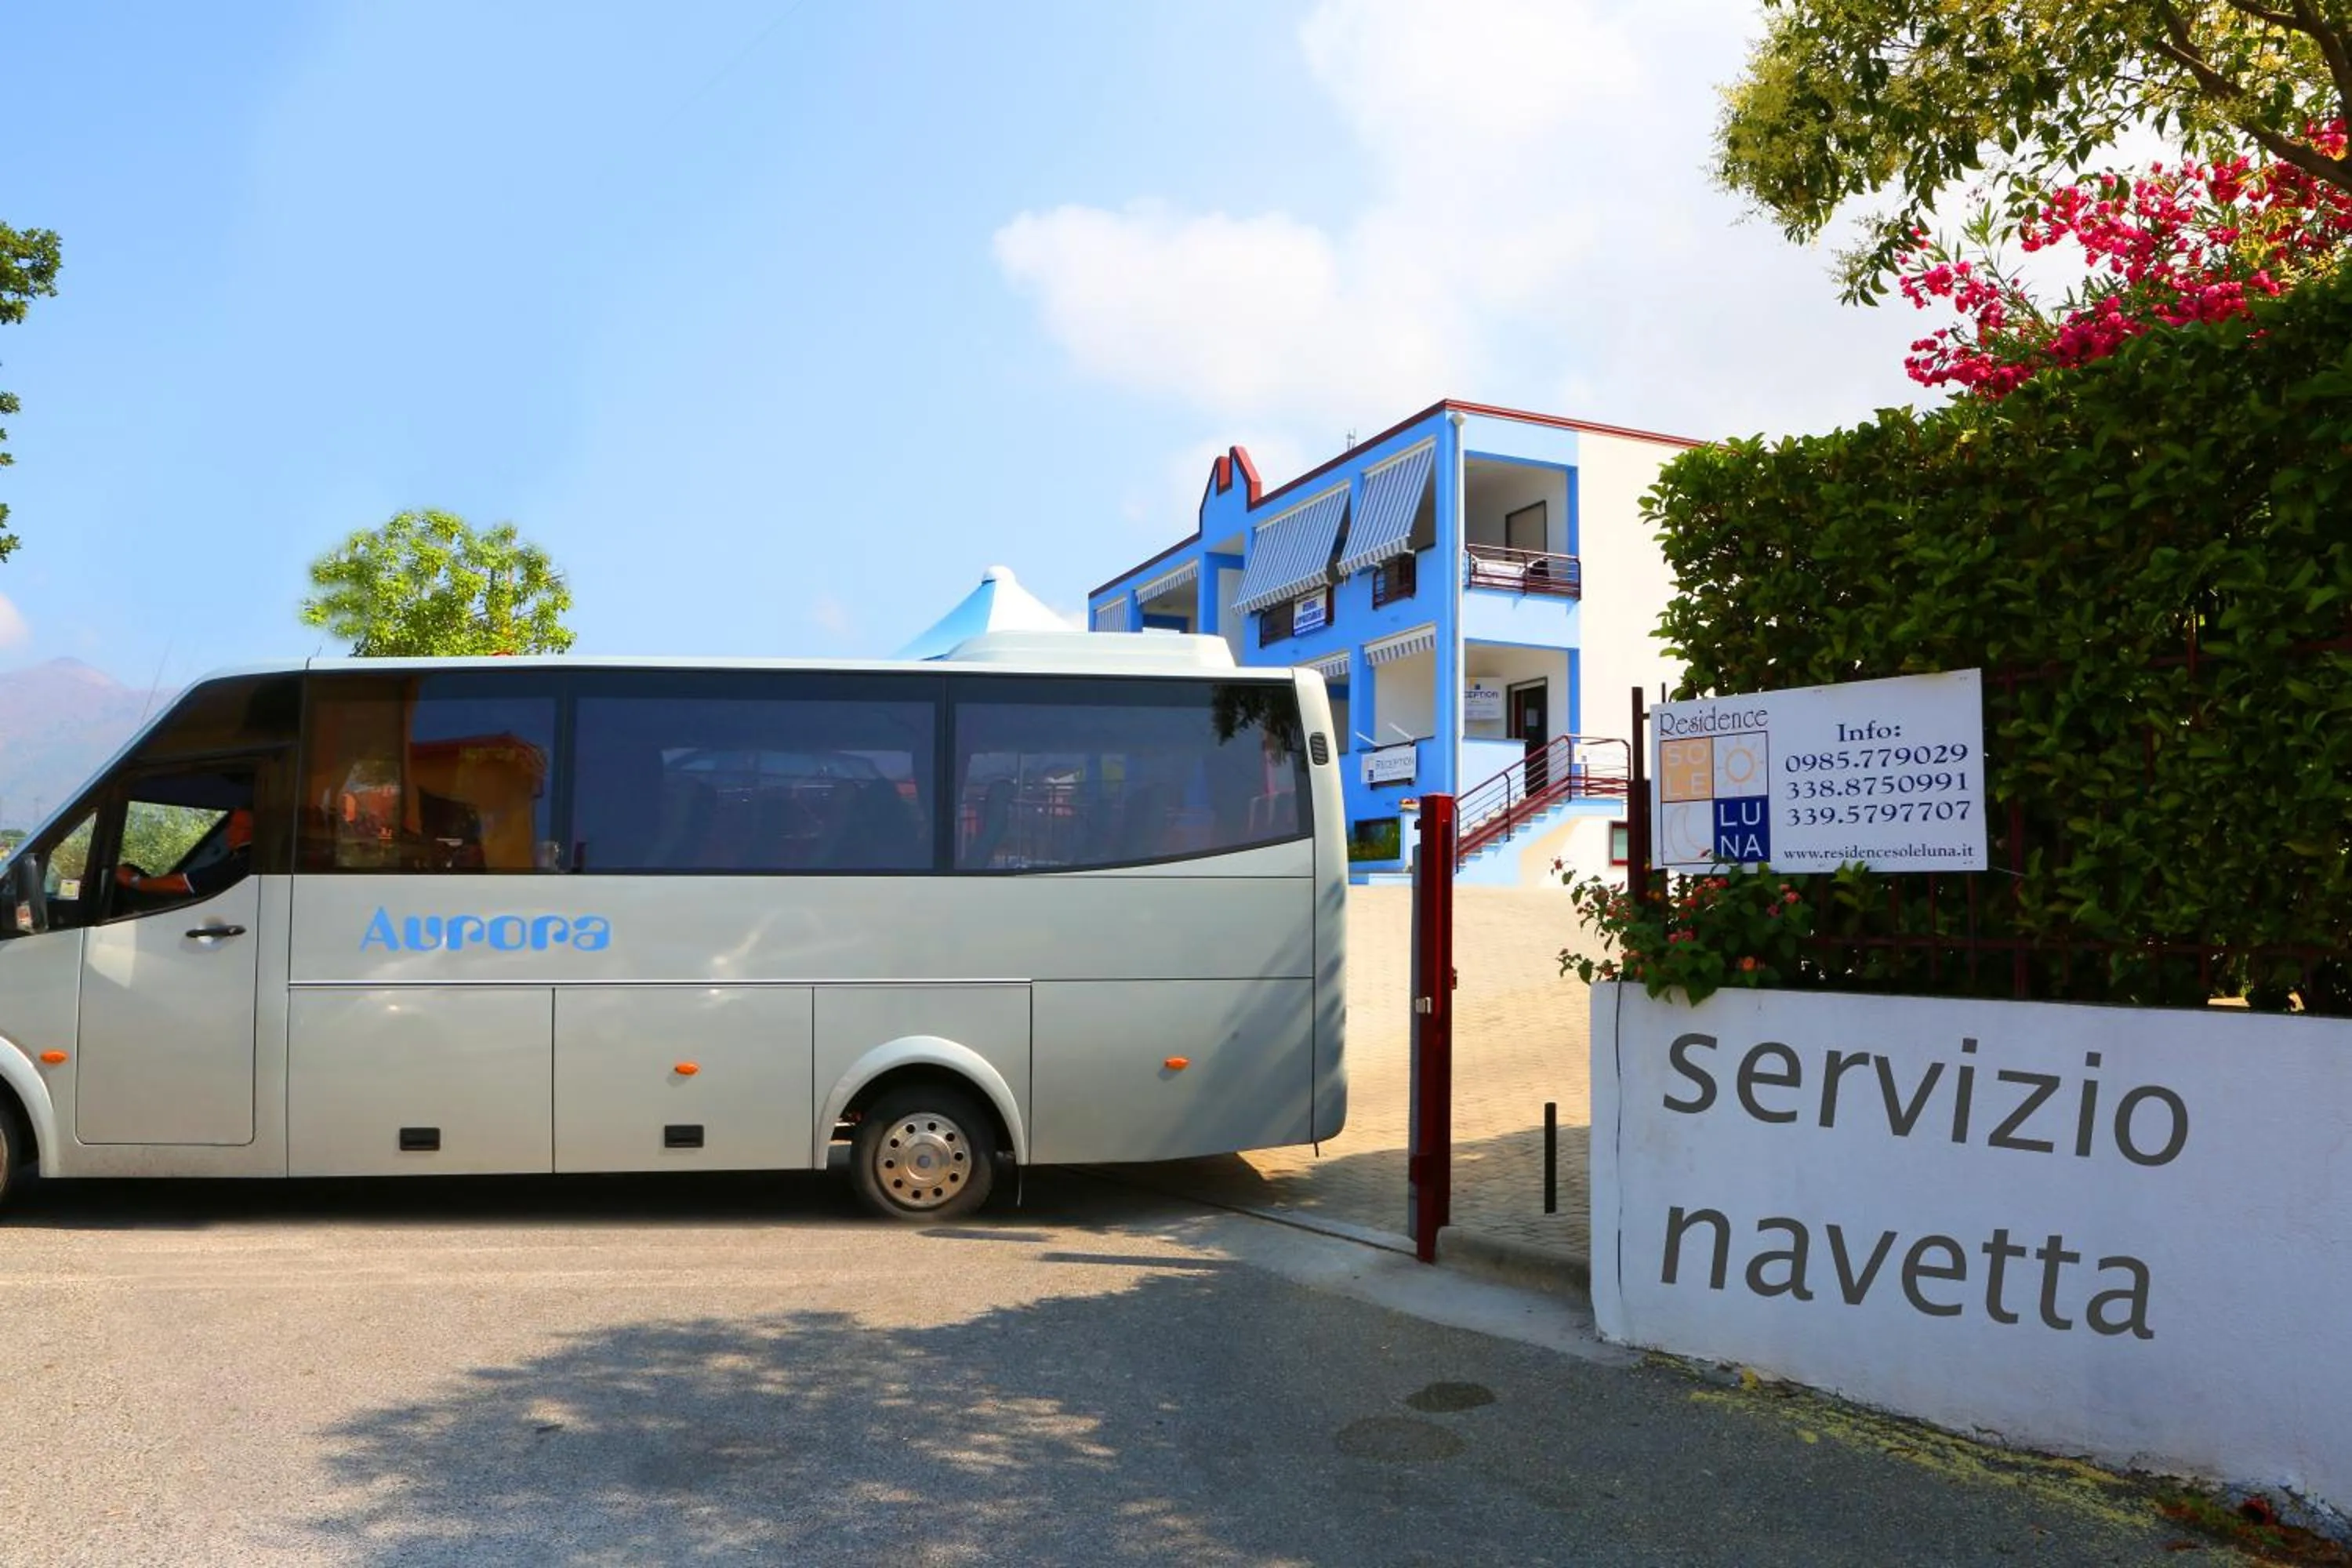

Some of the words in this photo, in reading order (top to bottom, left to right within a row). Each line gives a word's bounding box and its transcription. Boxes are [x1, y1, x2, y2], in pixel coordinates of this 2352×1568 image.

[1660, 706, 1768, 735] Residence
[1836, 720, 1901, 742] Info:
[1668, 742, 1707, 766] SO
[1785, 744, 1969, 772] 0985.779029
[1666, 772, 1708, 797] LE
[1785, 772, 1969, 800] 338.8750991
[1719, 802, 1761, 826] LU
[1786, 800, 1971, 826] 339.5797707
[1720, 834, 1763, 858] NA
[1784, 844, 1974, 859] www.residencesoleluna.it
[359, 906, 609, 952] Aurora
[1663, 1033, 2189, 1167] servizio
[1660, 1205, 2154, 1340] navetta
